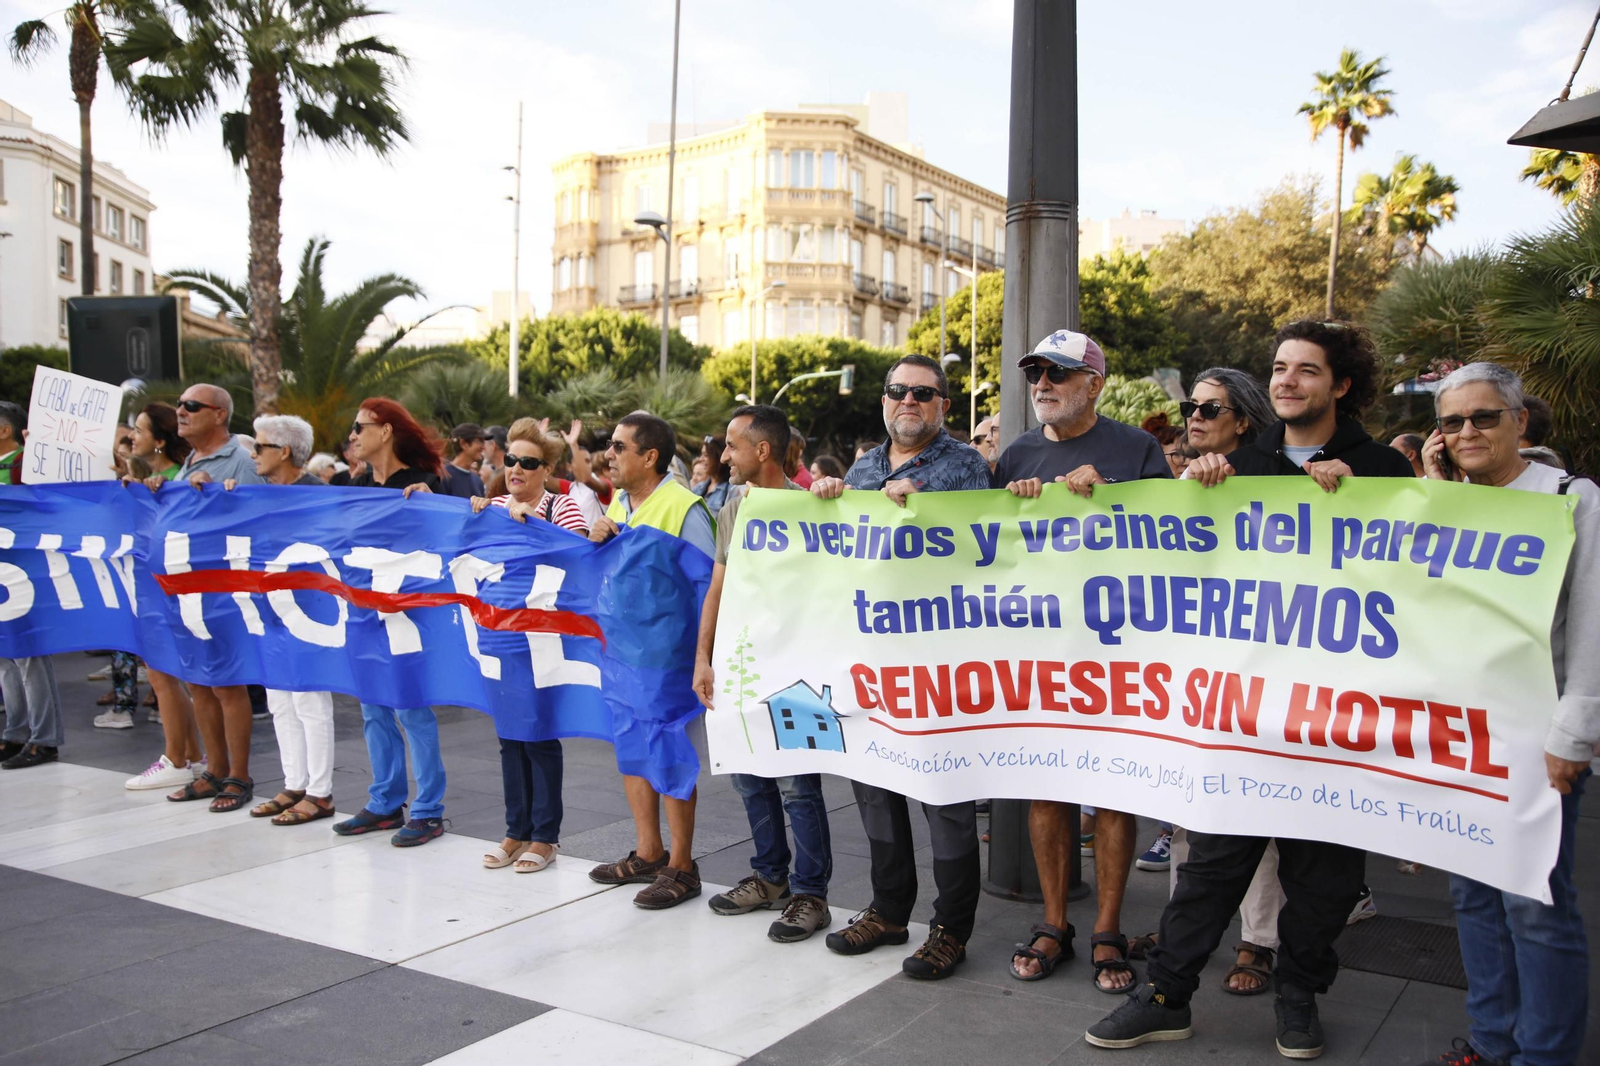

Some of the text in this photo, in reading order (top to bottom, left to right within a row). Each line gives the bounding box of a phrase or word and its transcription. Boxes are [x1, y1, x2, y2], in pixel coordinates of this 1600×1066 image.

[38, 375, 72, 411] CABO
[78, 386, 109, 423] GATA
[56, 418, 78, 443] NO
[32, 441, 49, 476] SE
[797, 513, 956, 561] vecinos
[968, 521, 1002, 567] y
[1018, 503, 1219, 554] vecinas
[1234, 501, 1311, 555] del
[1331, 517, 1546, 578] parque
[163, 530, 602, 691] HOTEL
[853, 574, 1400, 660] también QUEREMOS
[849, 659, 1509, 780] GENOVESES SIN HOTEL
[865, 740, 1495, 845] Asociación Vecinal de San José y El Pozo de los Frailes
